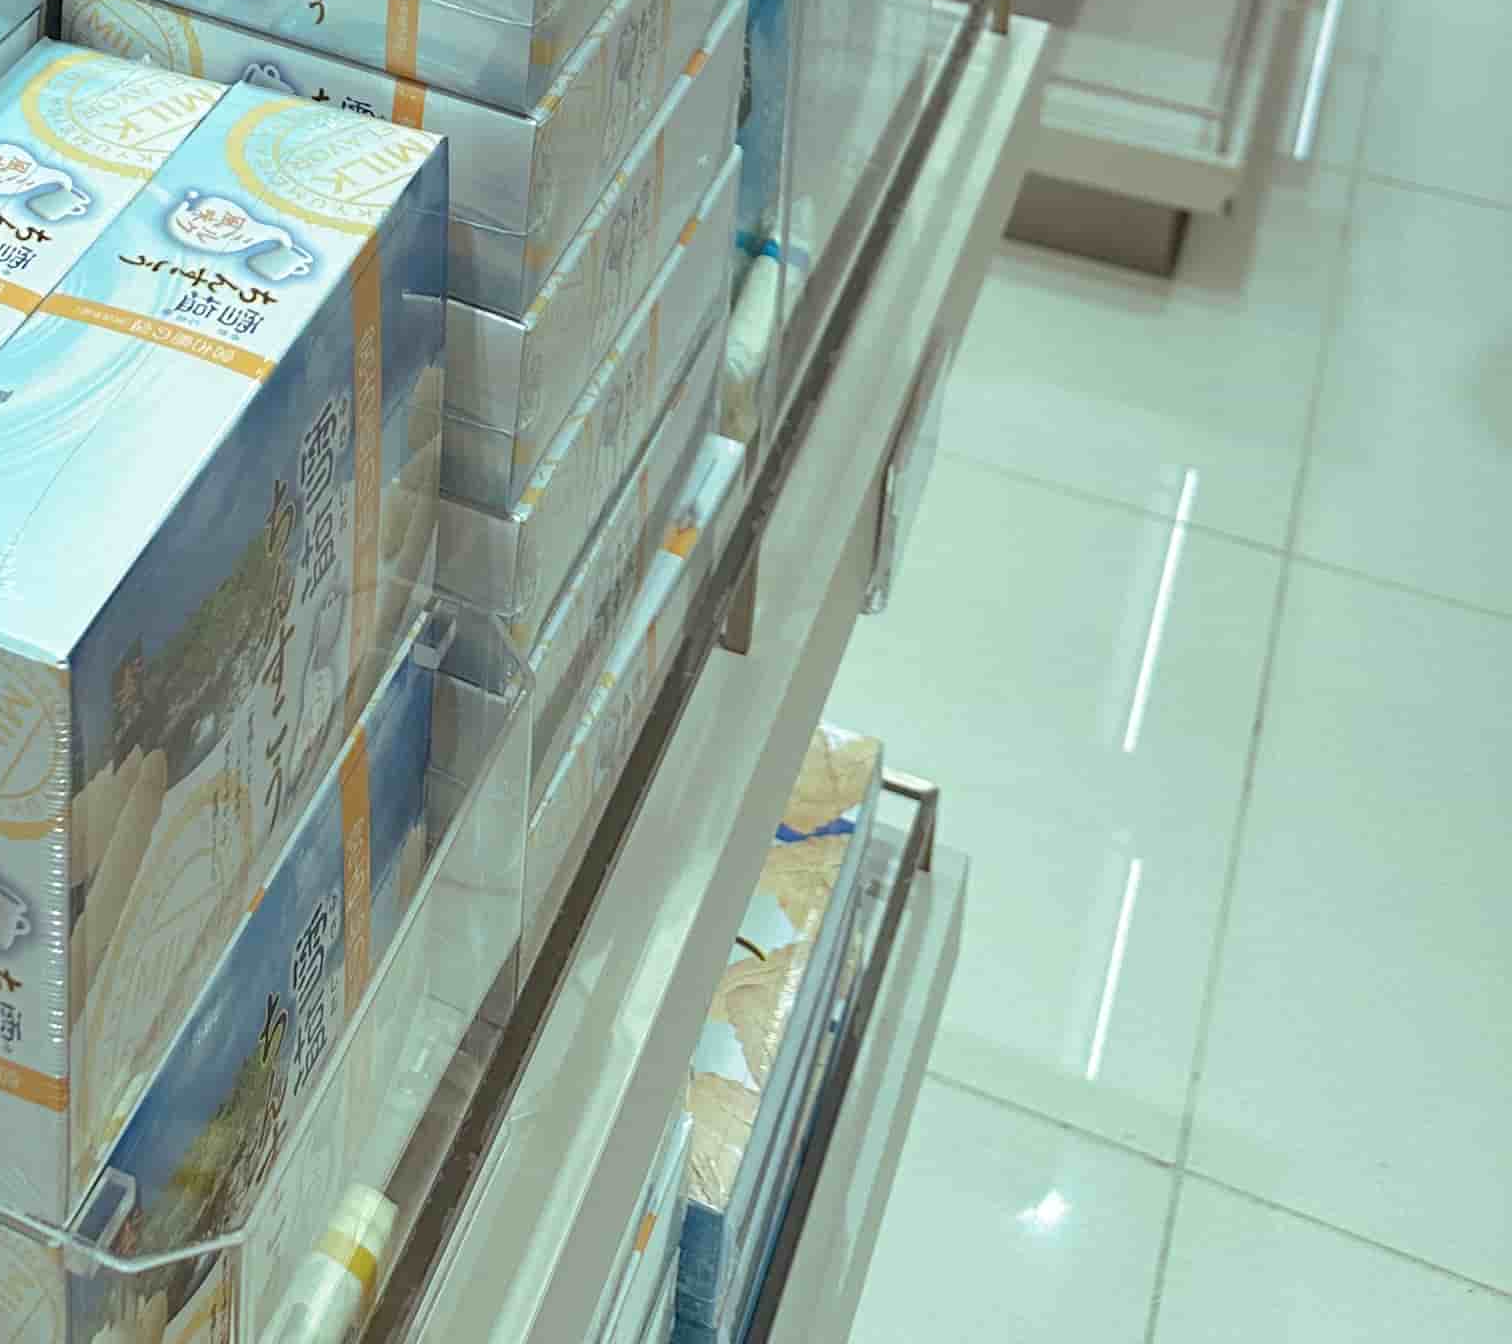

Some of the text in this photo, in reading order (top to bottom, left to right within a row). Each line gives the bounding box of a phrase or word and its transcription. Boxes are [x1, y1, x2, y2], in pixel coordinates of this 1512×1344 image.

[118, 253, 279, 307] ちんすこう
[299, 400, 338, 604] 雪塩
[291, 902, 329, 1099] 雪塩
